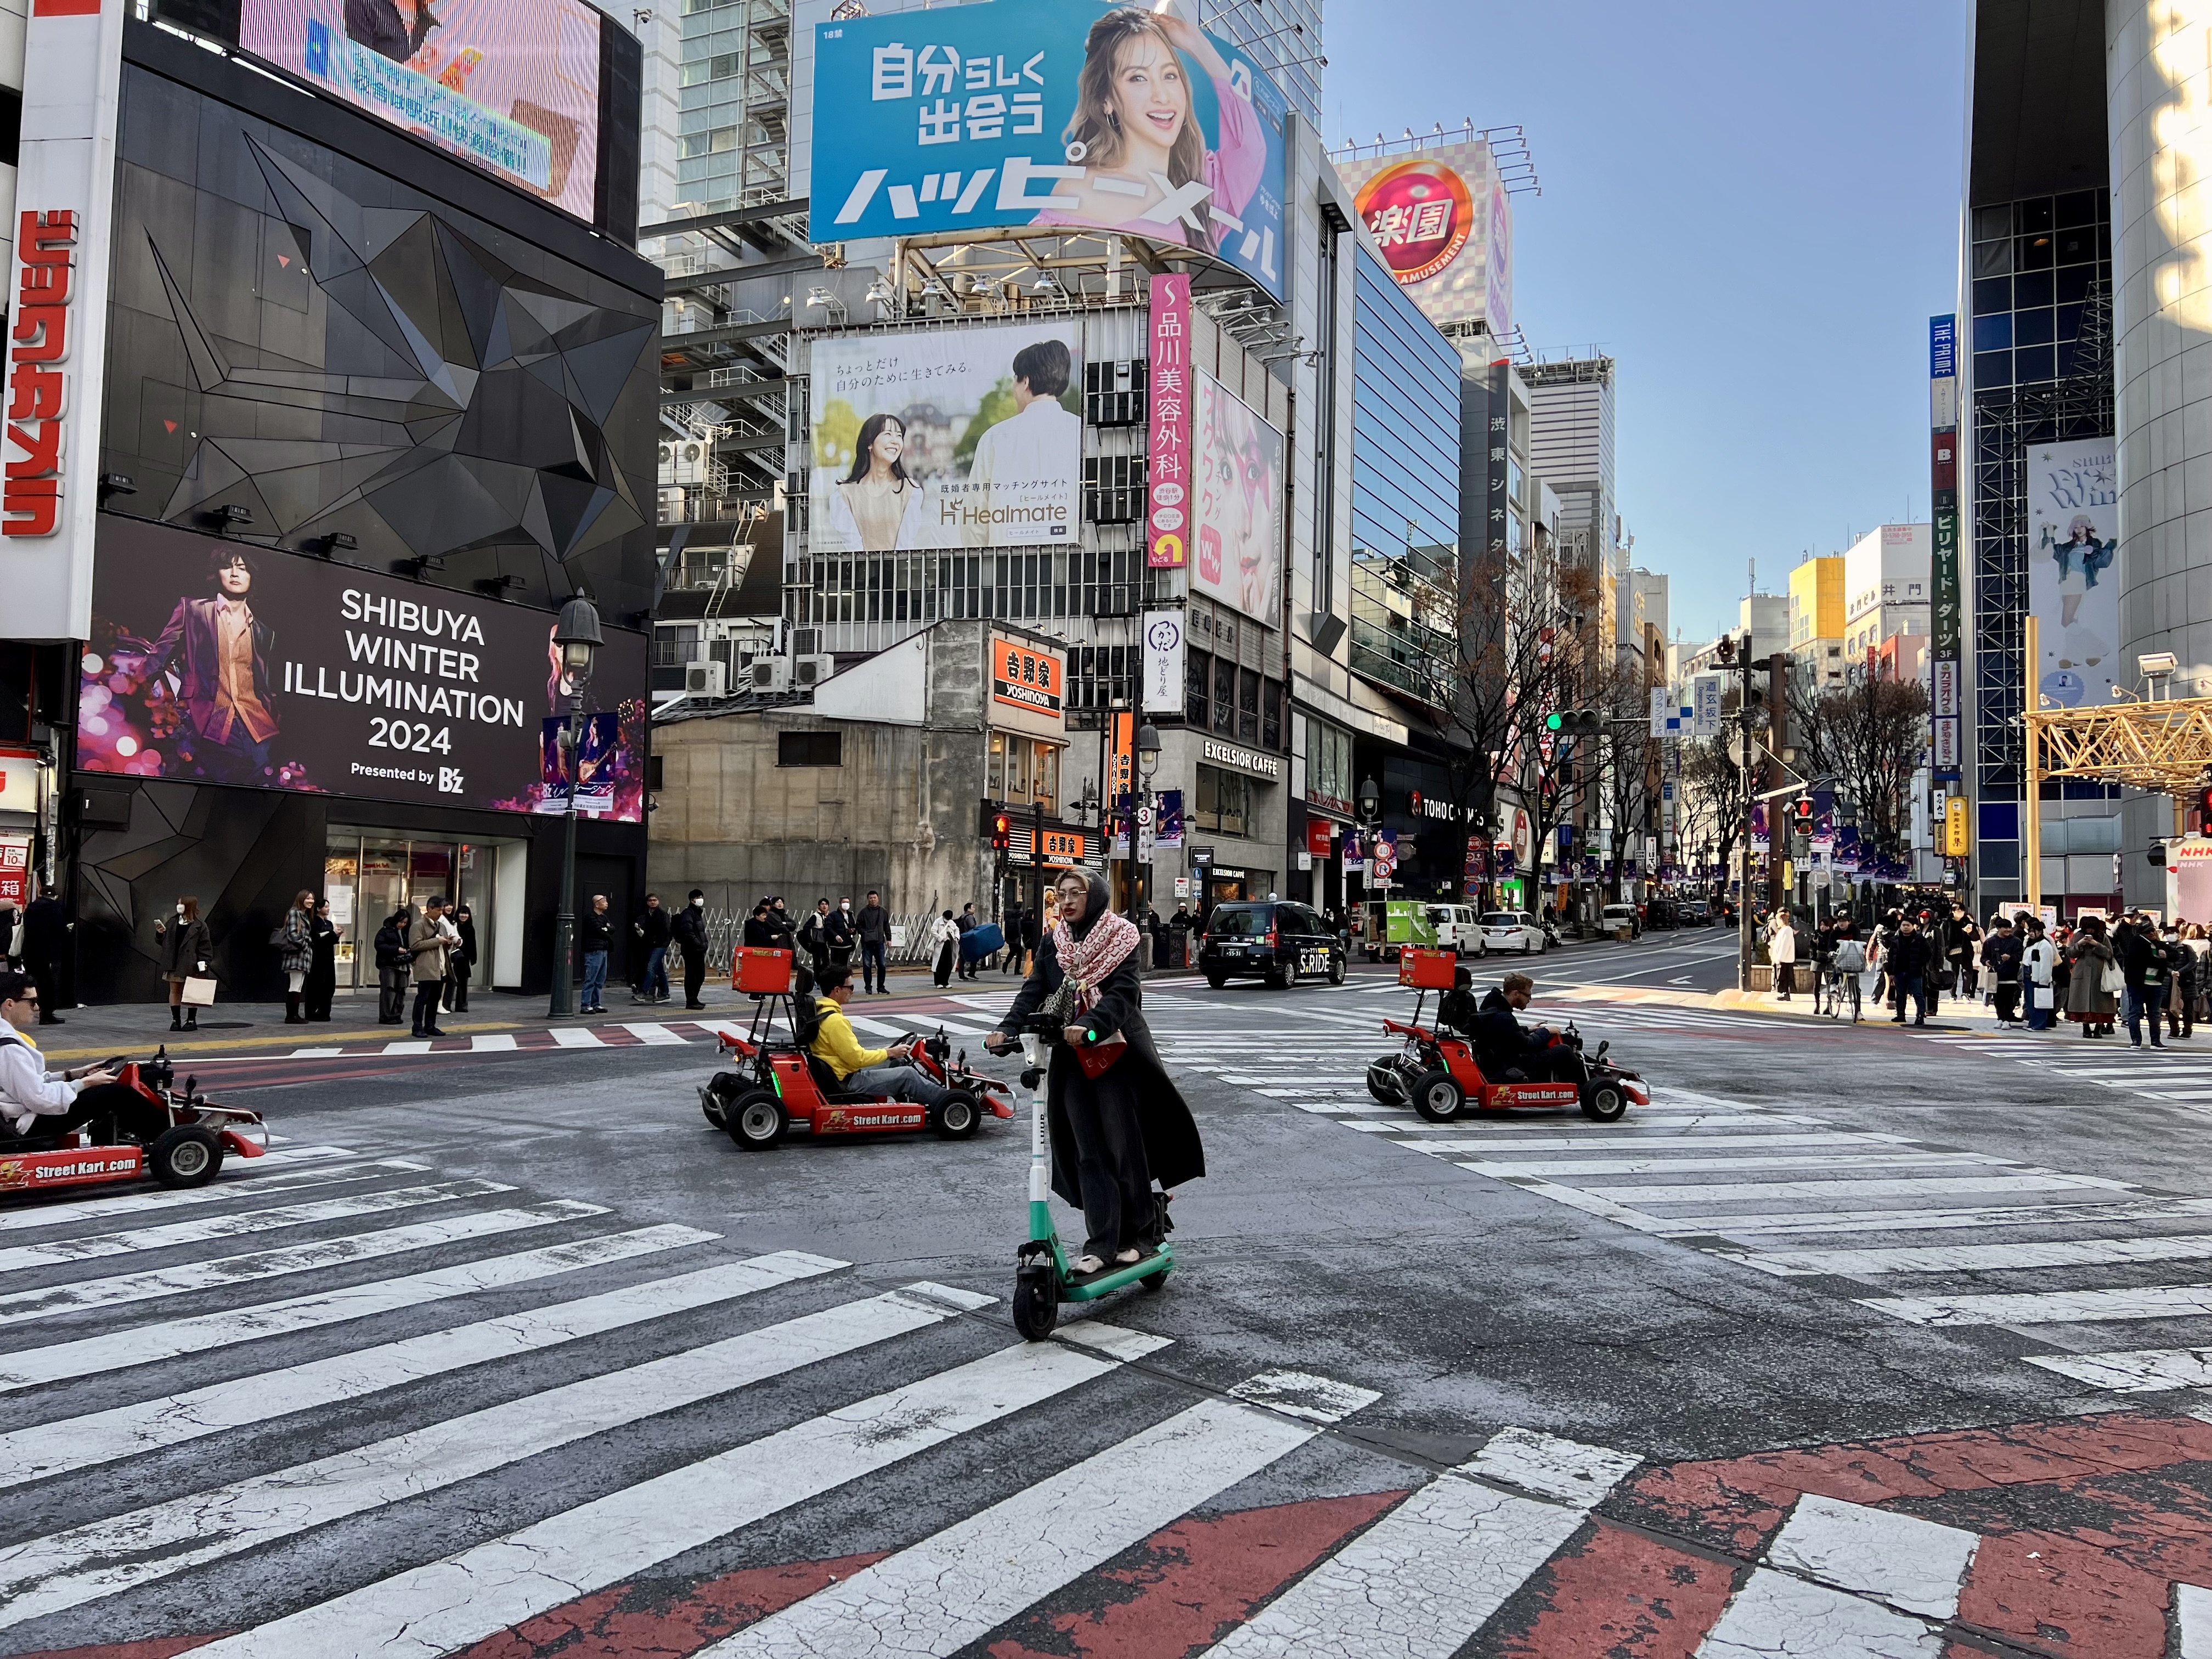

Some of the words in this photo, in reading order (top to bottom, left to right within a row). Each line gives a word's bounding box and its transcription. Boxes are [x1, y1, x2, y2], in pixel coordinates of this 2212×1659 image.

[822, 28, 843, 40] 18禁
[872, 42, 1045, 101] 自分らしく
[918, 92, 1043, 146] 出会う
[833, 141, 1276, 283] ハッピーメール
[1372, 199, 1453, 247] 楽園
[1400, 233, 1466, 285] AMUSEMENT
[1934, 323, 1951, 341] THE
[836, 356, 898, 376] ちょっとだけ
[1935, 343, 1951, 374] PRIME
[836, 361, 972, 392] 自分のために生きてみる。
[1156, 312, 1182, 479] 品川美容外科
[1202, 385, 1214, 517] ワクワク
[940, 478, 1068, 493] 既婚者専用マッチングサイト
[963, 504, 1067, 526] Healmate
[1882, 584, 1921, 596] 井門
[1936, 515, 1953, 646] ビリヤード・ダーツ
[341, 589, 486, 647] SHIBUYA
[1157, 620, 1172, 652] つかだ
[345, 630, 479, 683] WINTER
[1007, 651, 1050, 689] 吉野家
[1156, 657, 1170, 698] 地どり屋
[1941, 671, 1951, 706] カラオケ
[284, 661, 524, 727] ILLUMINATION
[1006, 684, 1049, 707] YOSHINOYA
[1706, 681, 1717, 730] 道玄坂下
[1655, 690, 1663, 735] スクランブル式
[368, 716, 452, 755] 2024
[1204, 740, 1251, 769] EXCELSIOR
[1252, 757, 1277, 776] CAFFÉ
[351, 762, 415, 782] Presented
[418, 768, 434, 785] by
[439, 766, 464, 794] B'z
[1140, 809, 1148, 822] 3
[1424, 799, 1447, 819] TOHO
[1048, 834, 1075, 854] 吉野家
[1049, 855, 1073, 864] YOSHINOYA
[1, 880, 19, 895] 箱
[1212, 868, 1233, 877] EXCELSIOR
[1300, 954, 1330, 973] S.RIDE
[1517, 1091, 1541, 1099] Street
[1542, 1091, 1556, 1099] Kart
[853, 1115, 879, 1126] Street
[881, 1115, 900, 1125] Kart
[901, 1114, 921, 1124] .com
[35, 1165, 76, 1179] Street
[78, 1162, 105, 1174] Kart
[106, 1159, 136, 1171] .com
